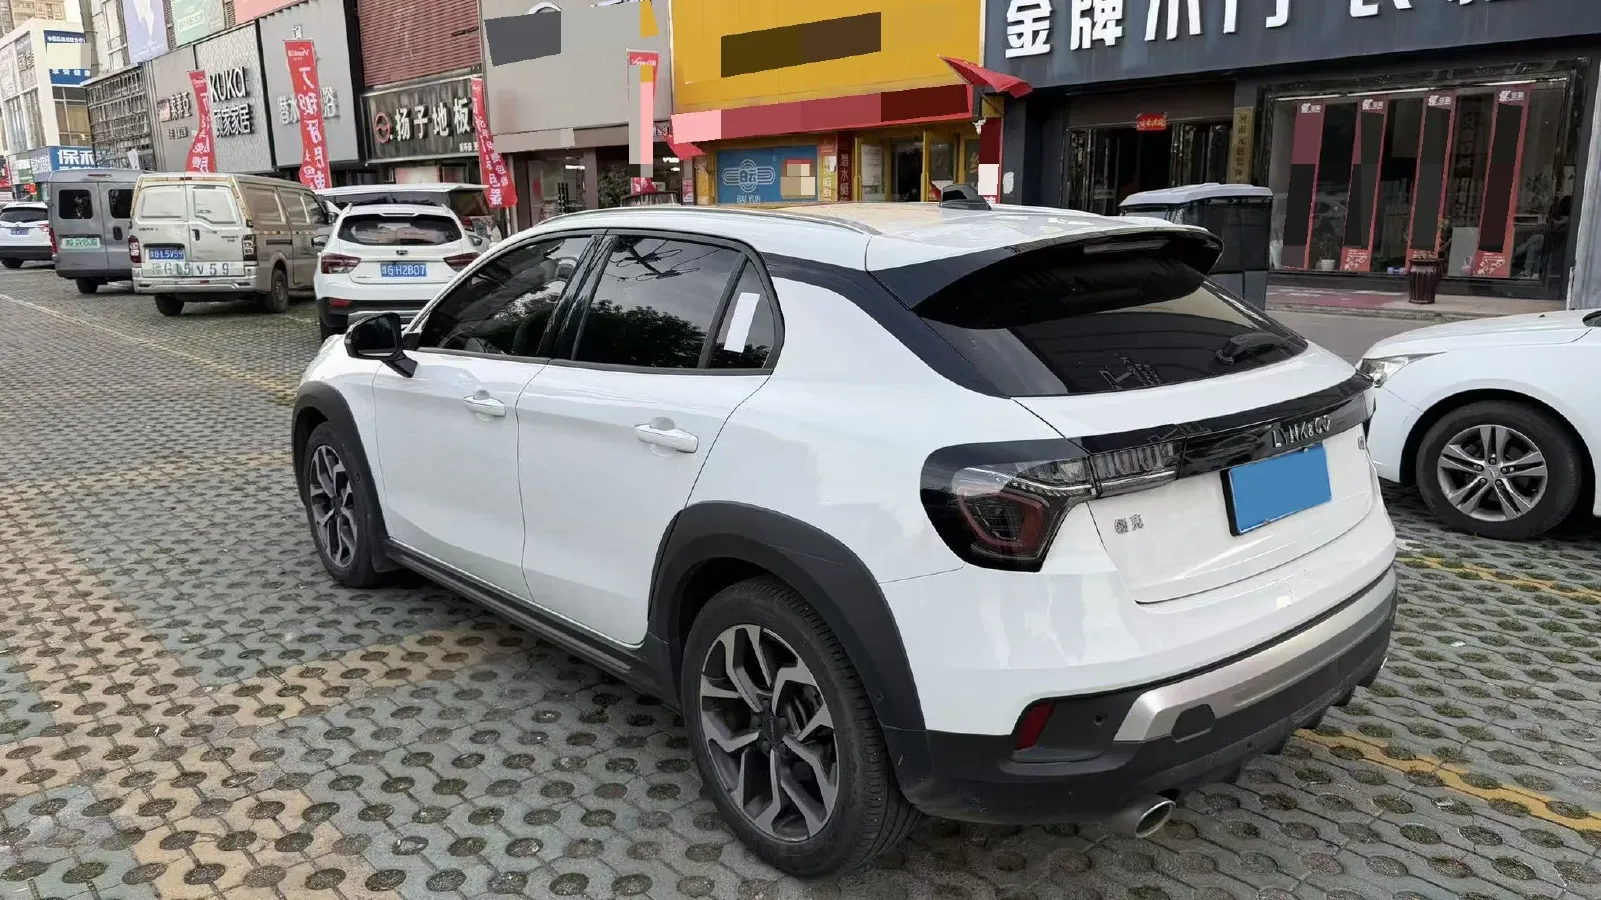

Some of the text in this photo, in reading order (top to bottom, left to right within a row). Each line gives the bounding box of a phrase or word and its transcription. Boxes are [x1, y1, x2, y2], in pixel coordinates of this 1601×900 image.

[395, 98, 471, 142] 扬子地板
[1272, 414, 1331, 448] LYNK&CO
